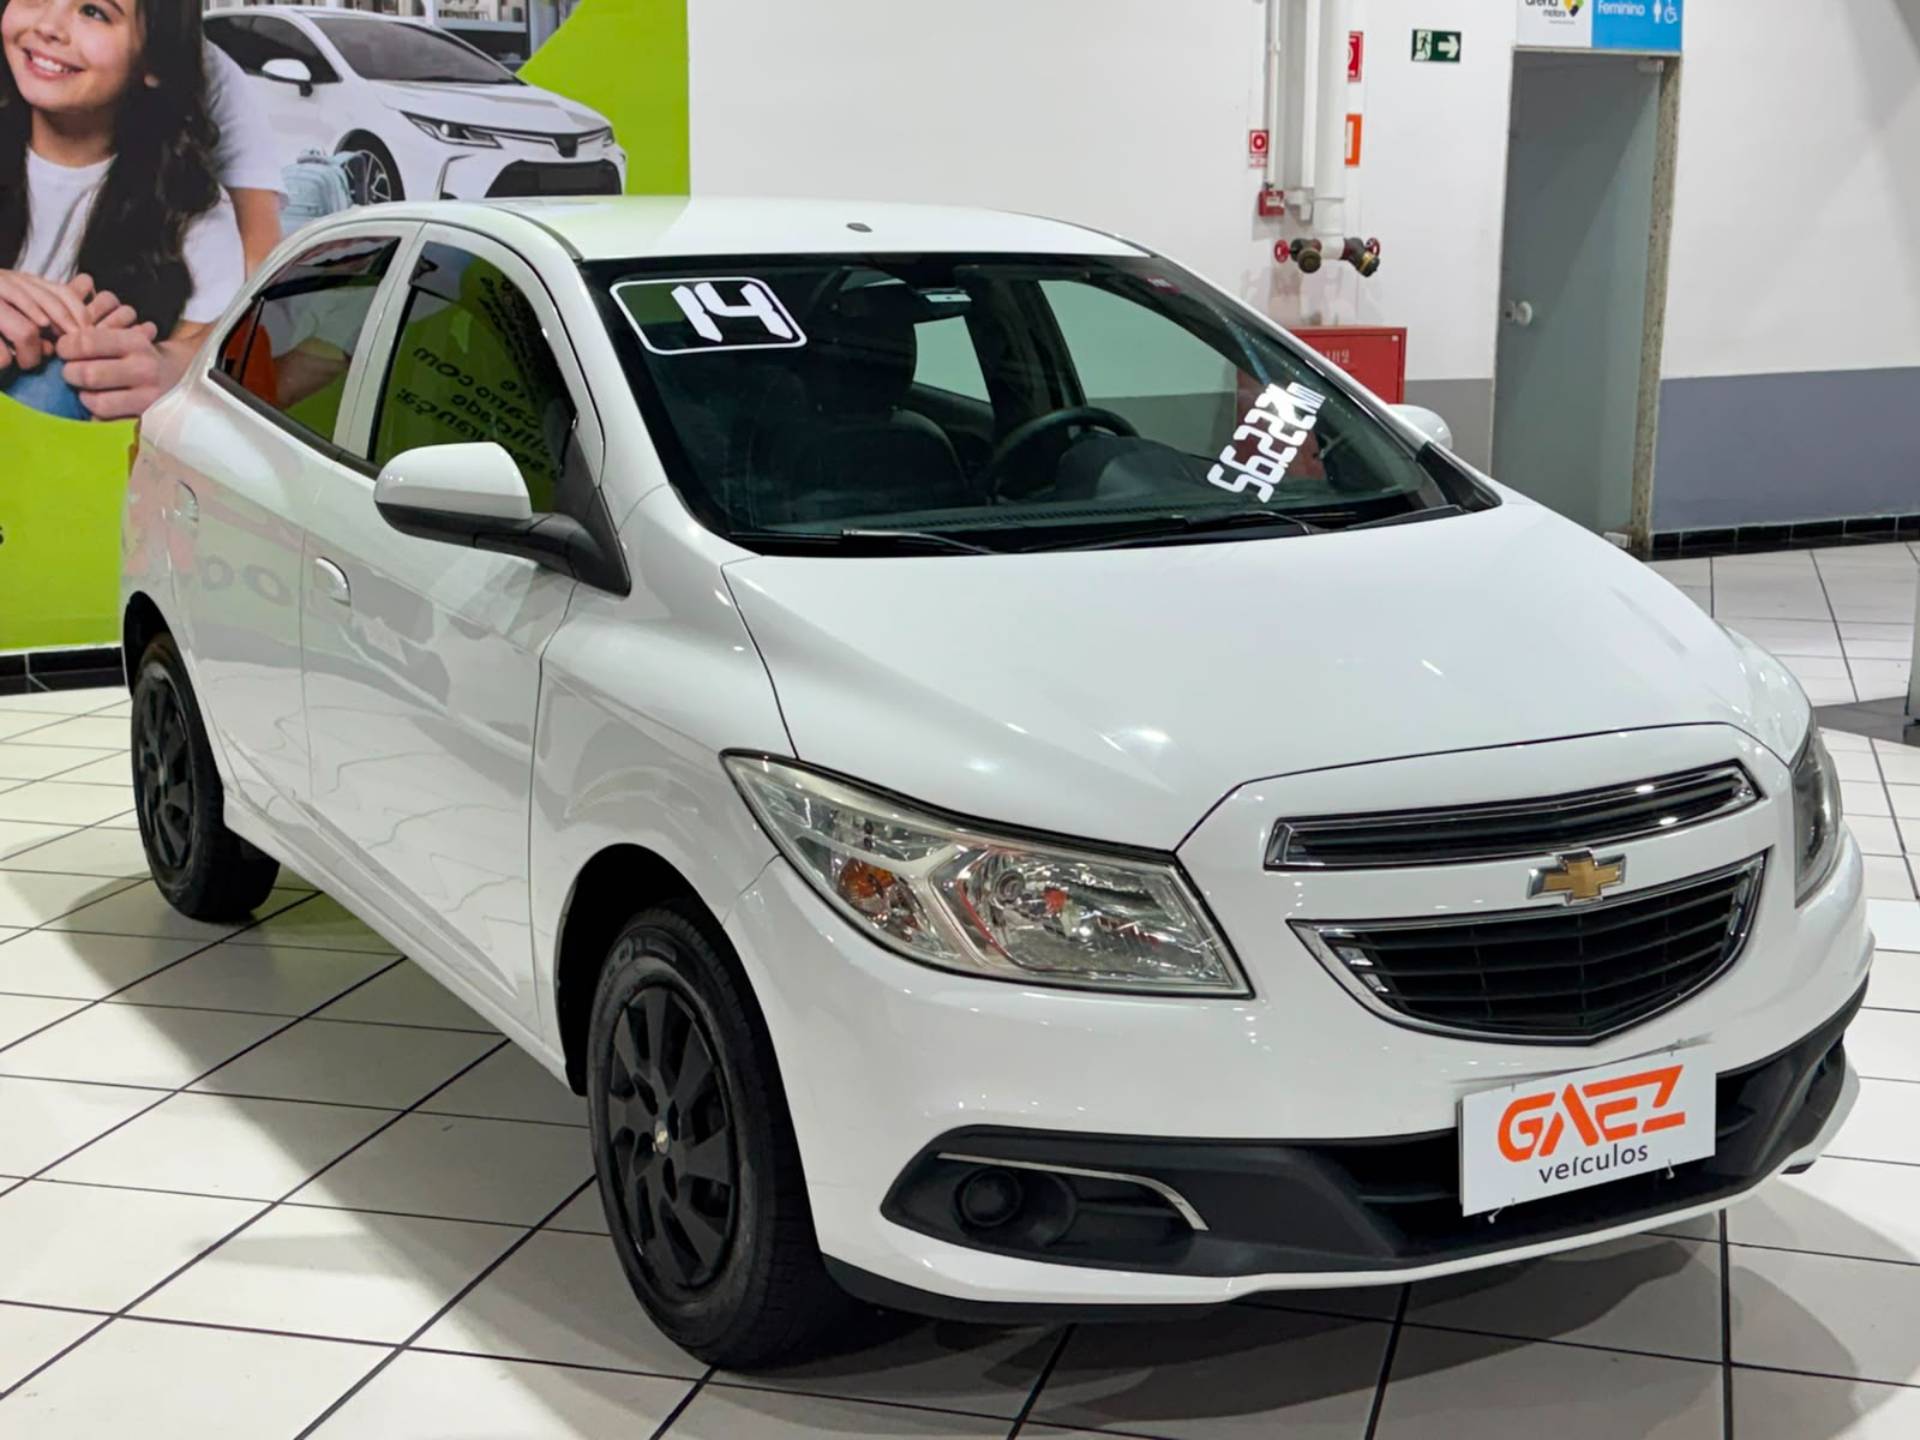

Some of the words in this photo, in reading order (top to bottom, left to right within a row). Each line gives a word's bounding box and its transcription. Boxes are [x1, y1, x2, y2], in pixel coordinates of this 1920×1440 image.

[671, 281, 793, 343] 14
[1497, 1064, 1686, 1163] GAEZ
[1538, 1143, 1649, 1184] veículos
